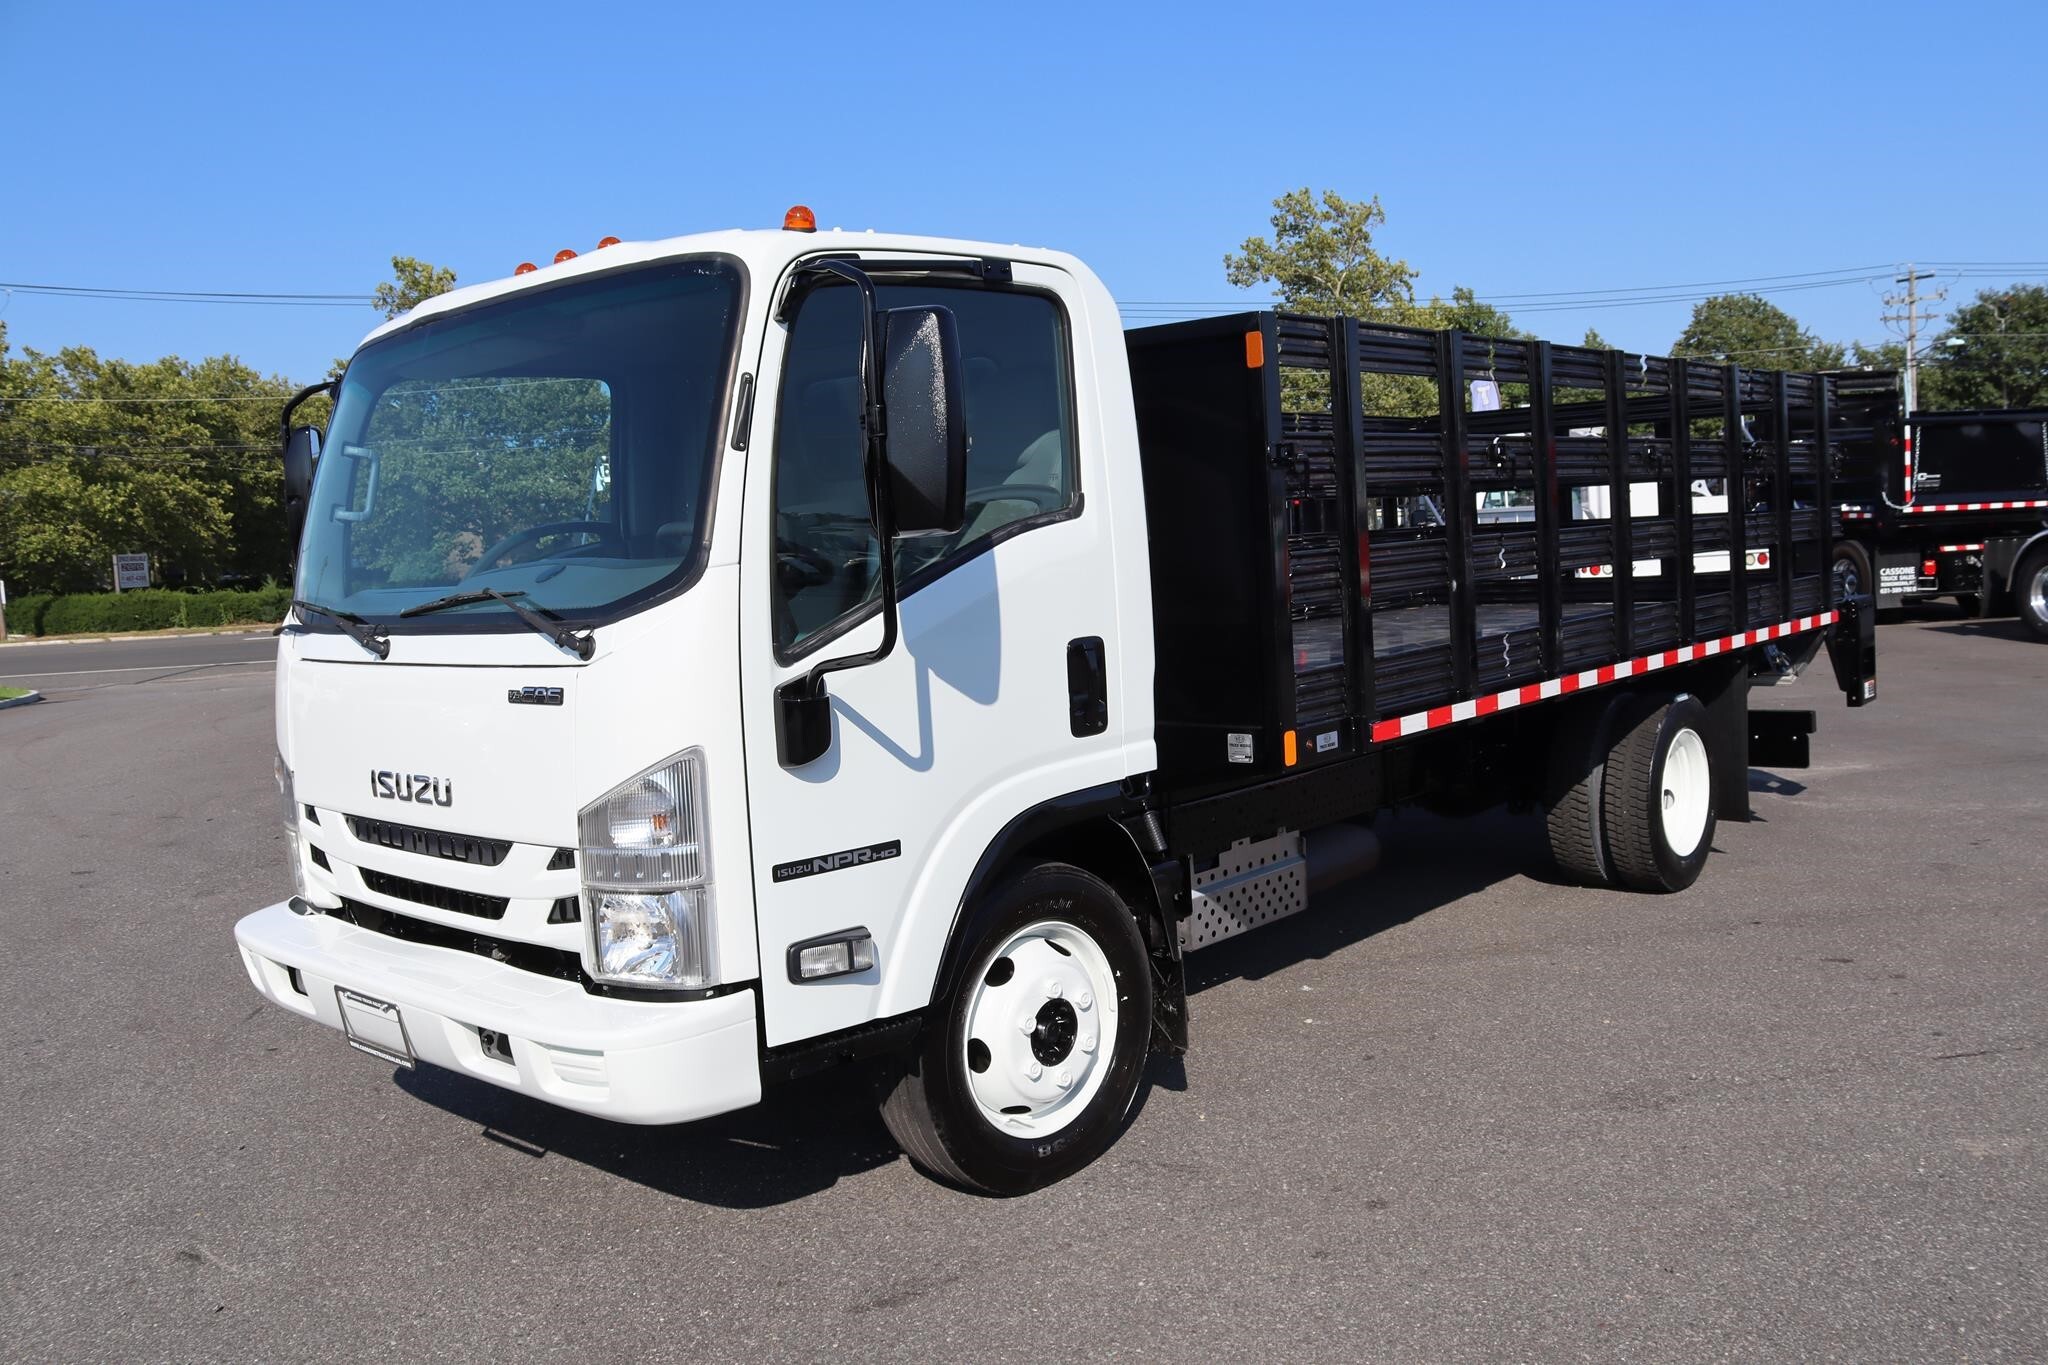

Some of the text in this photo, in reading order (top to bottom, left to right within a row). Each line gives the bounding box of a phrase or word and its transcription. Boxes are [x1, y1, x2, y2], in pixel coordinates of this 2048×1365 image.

[1880, 566, 1916, 576] CASSONE
[370, 769, 452, 808] ISUZU
[777, 848, 897, 878] ISUZU NPR HD
